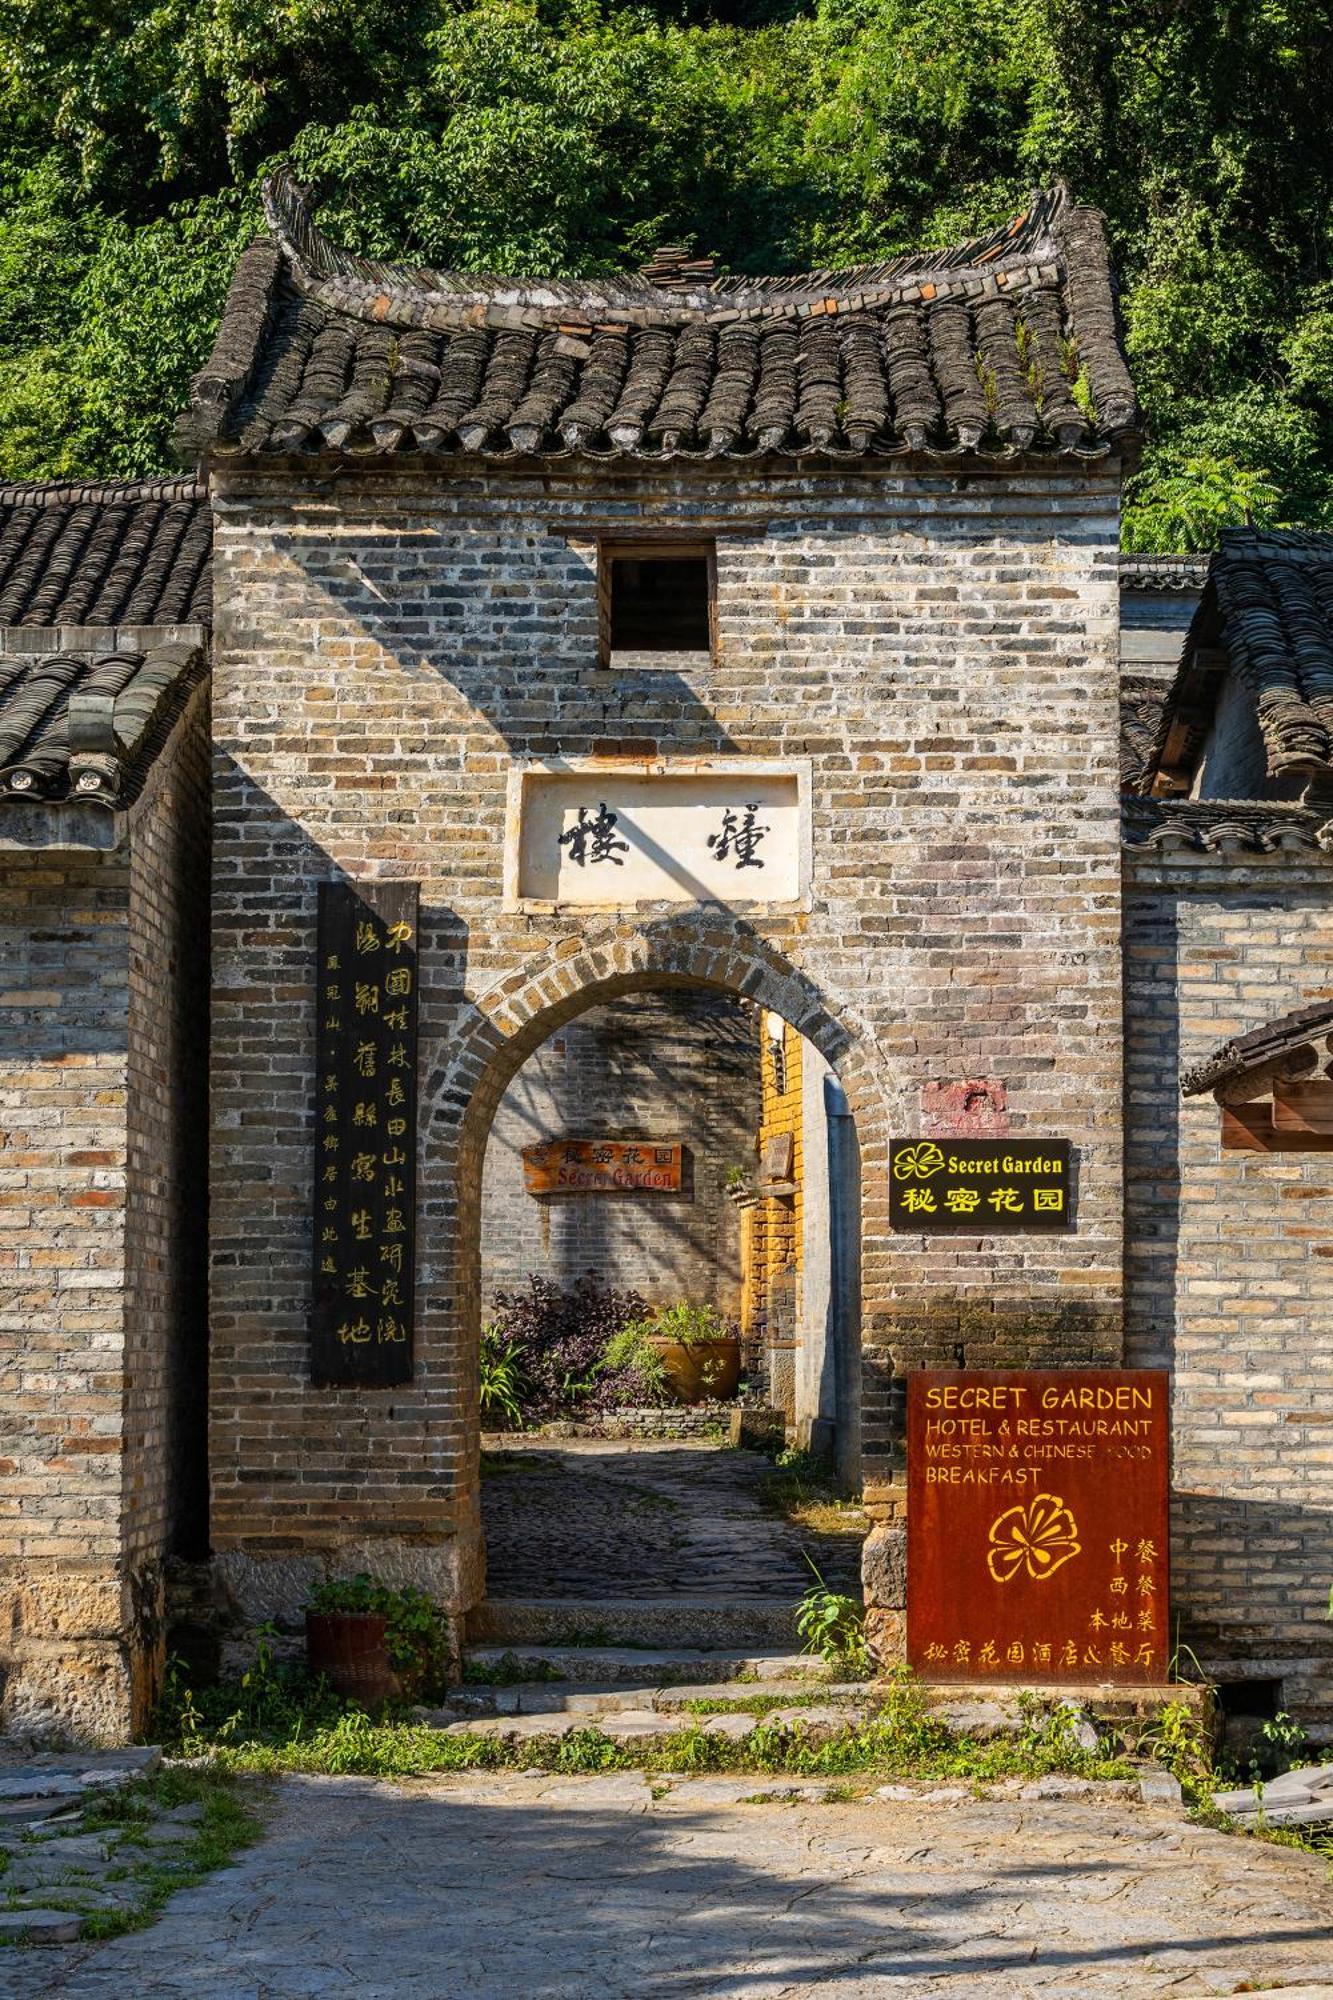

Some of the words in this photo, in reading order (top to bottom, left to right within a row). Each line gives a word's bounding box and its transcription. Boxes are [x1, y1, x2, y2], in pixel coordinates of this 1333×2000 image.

[948, 1156, 999, 1174] Secret
[1002, 1156, 1062, 1174] Garden
[613, 1168, 672, 1187] Garden
[900, 1187, 1063, 1213] 秘密花园
[925, 1386, 1028, 1410] SECRET
[1041, 1386, 1153, 1410] GARDEN
[926, 1419, 992, 1436] HOTEL
[997, 1419, 1010, 1436] &
[1017, 1419, 1153, 1436] RESTAURANT
[925, 1444, 1004, 1458] WESTERN
[1008, 1444, 1019, 1458] &
[1024, 1444, 1096, 1458] CHINESE
[925, 1467, 1043, 1484] BREAKFAST
[1109, 1538, 1159, 1565] 中餐
[1109, 1575, 1158, 1595] 西餐
[1088, 1608, 1157, 1632] 本地菜
